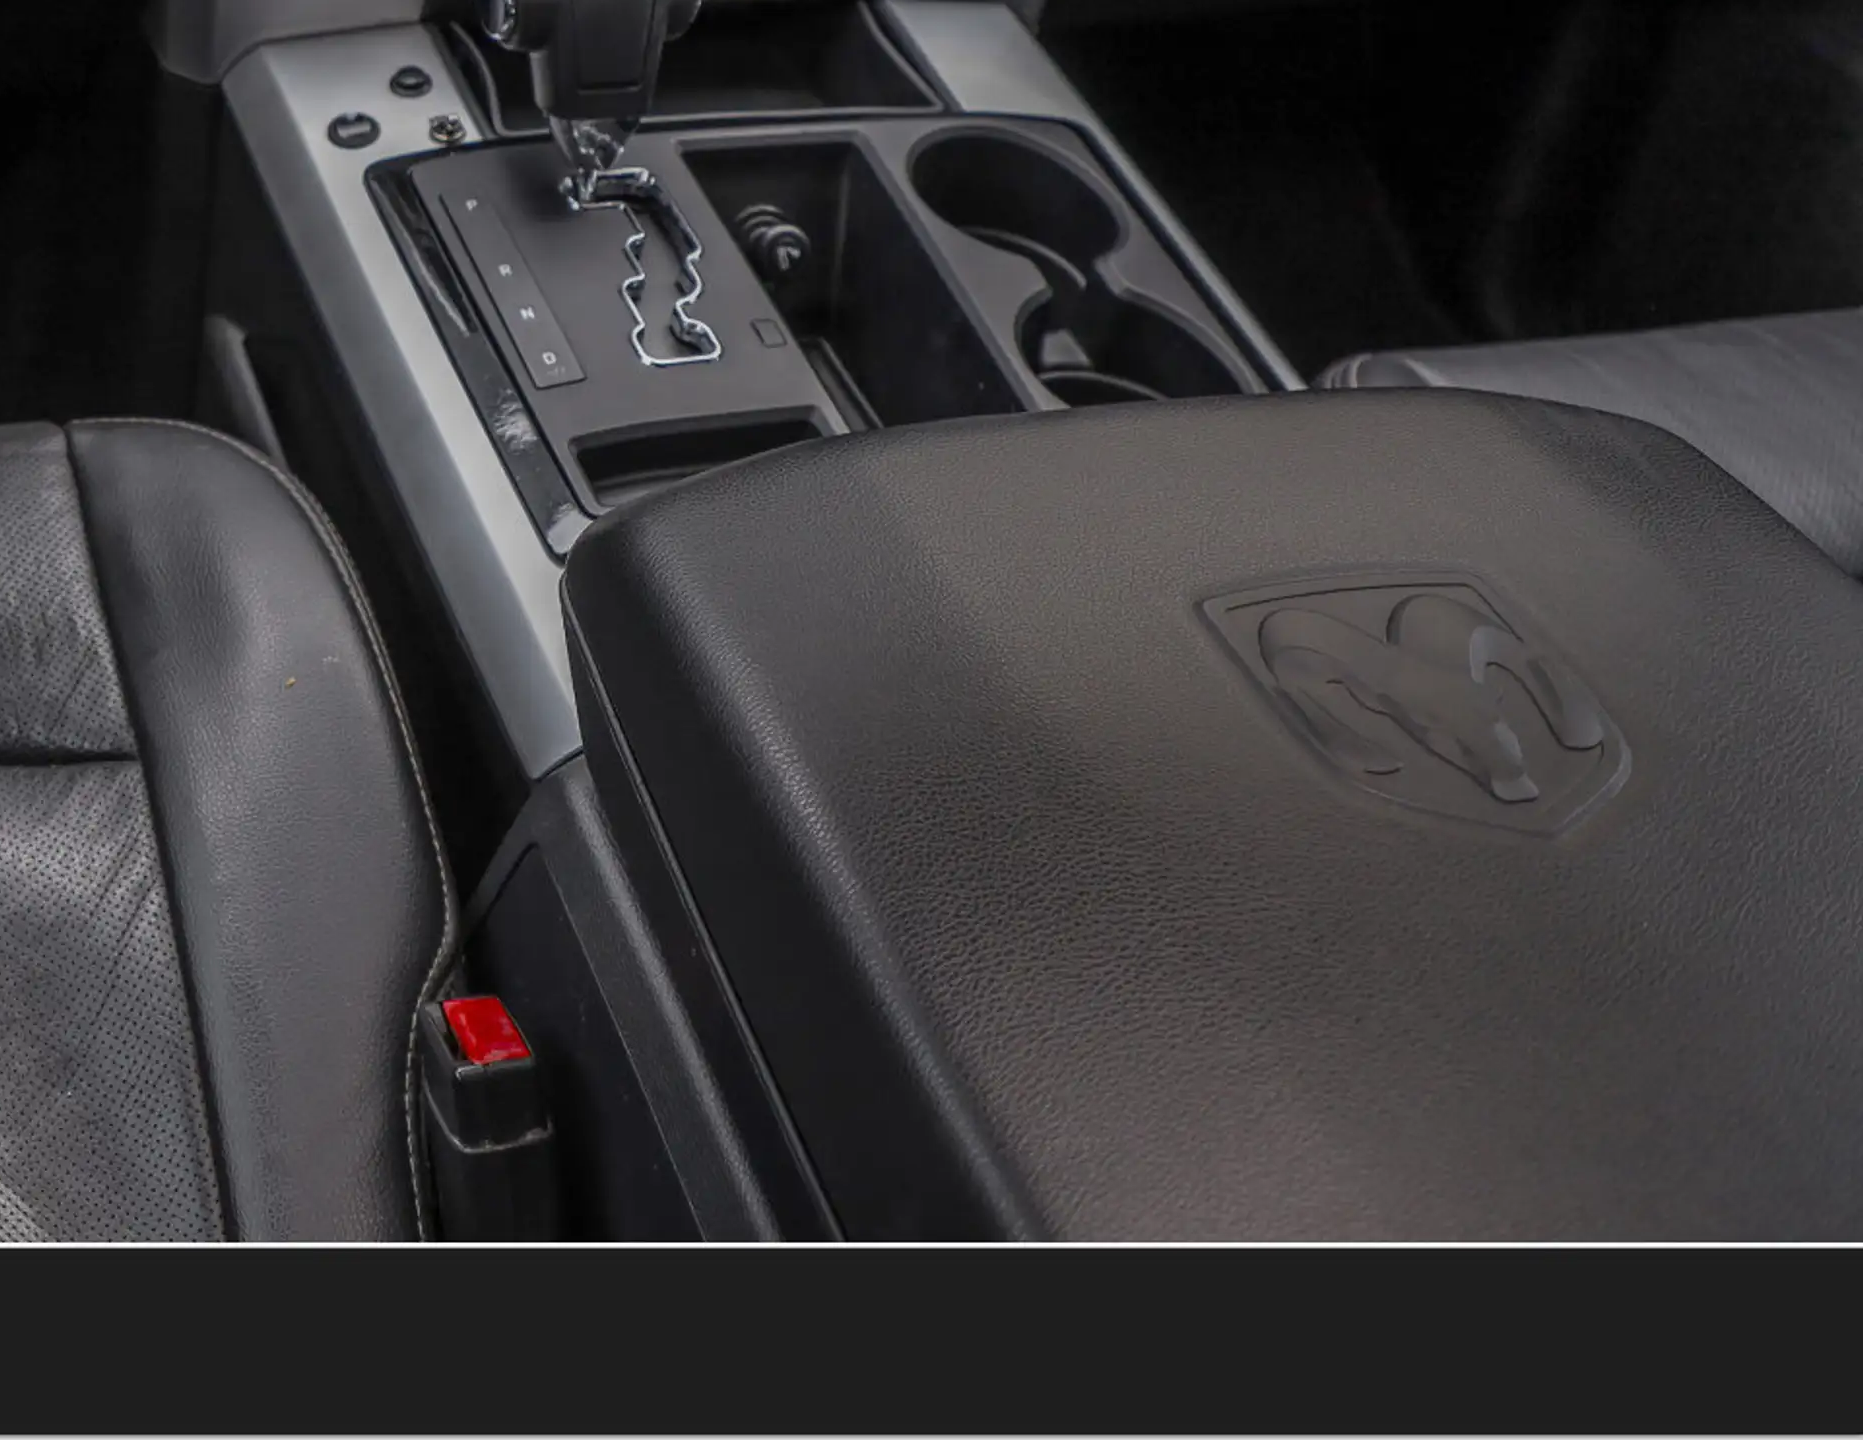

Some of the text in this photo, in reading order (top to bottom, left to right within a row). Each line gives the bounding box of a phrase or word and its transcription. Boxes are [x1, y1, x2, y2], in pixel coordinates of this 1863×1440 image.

[497, 263, 513, 277] R
[519, 306, 535, 320] N
[542, 350, 557, 365] D
